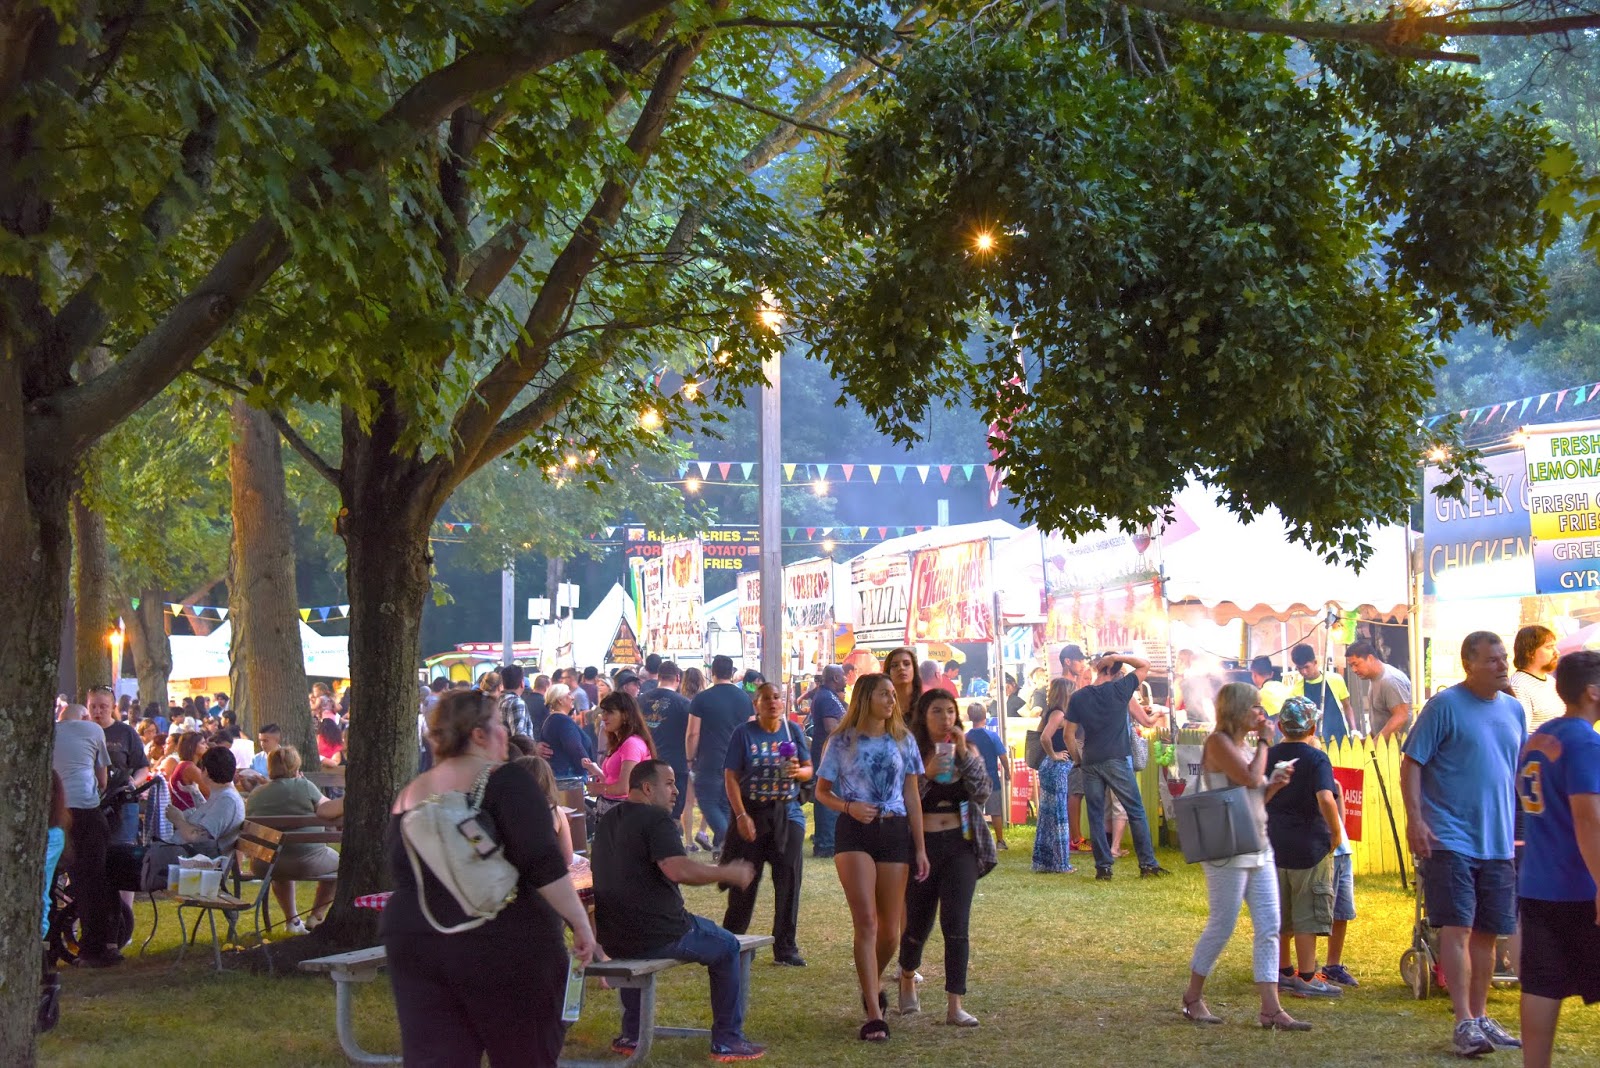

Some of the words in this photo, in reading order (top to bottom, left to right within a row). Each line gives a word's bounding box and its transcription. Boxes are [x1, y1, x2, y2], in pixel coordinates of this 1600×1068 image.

[1532, 493, 1588, 514] FRESH
[702, 545, 747, 557] POTATO
[703, 558, 743, 570] FRIES
[858, 584, 909, 627] PIZZA
[1344, 788, 1363, 805] AISLE
